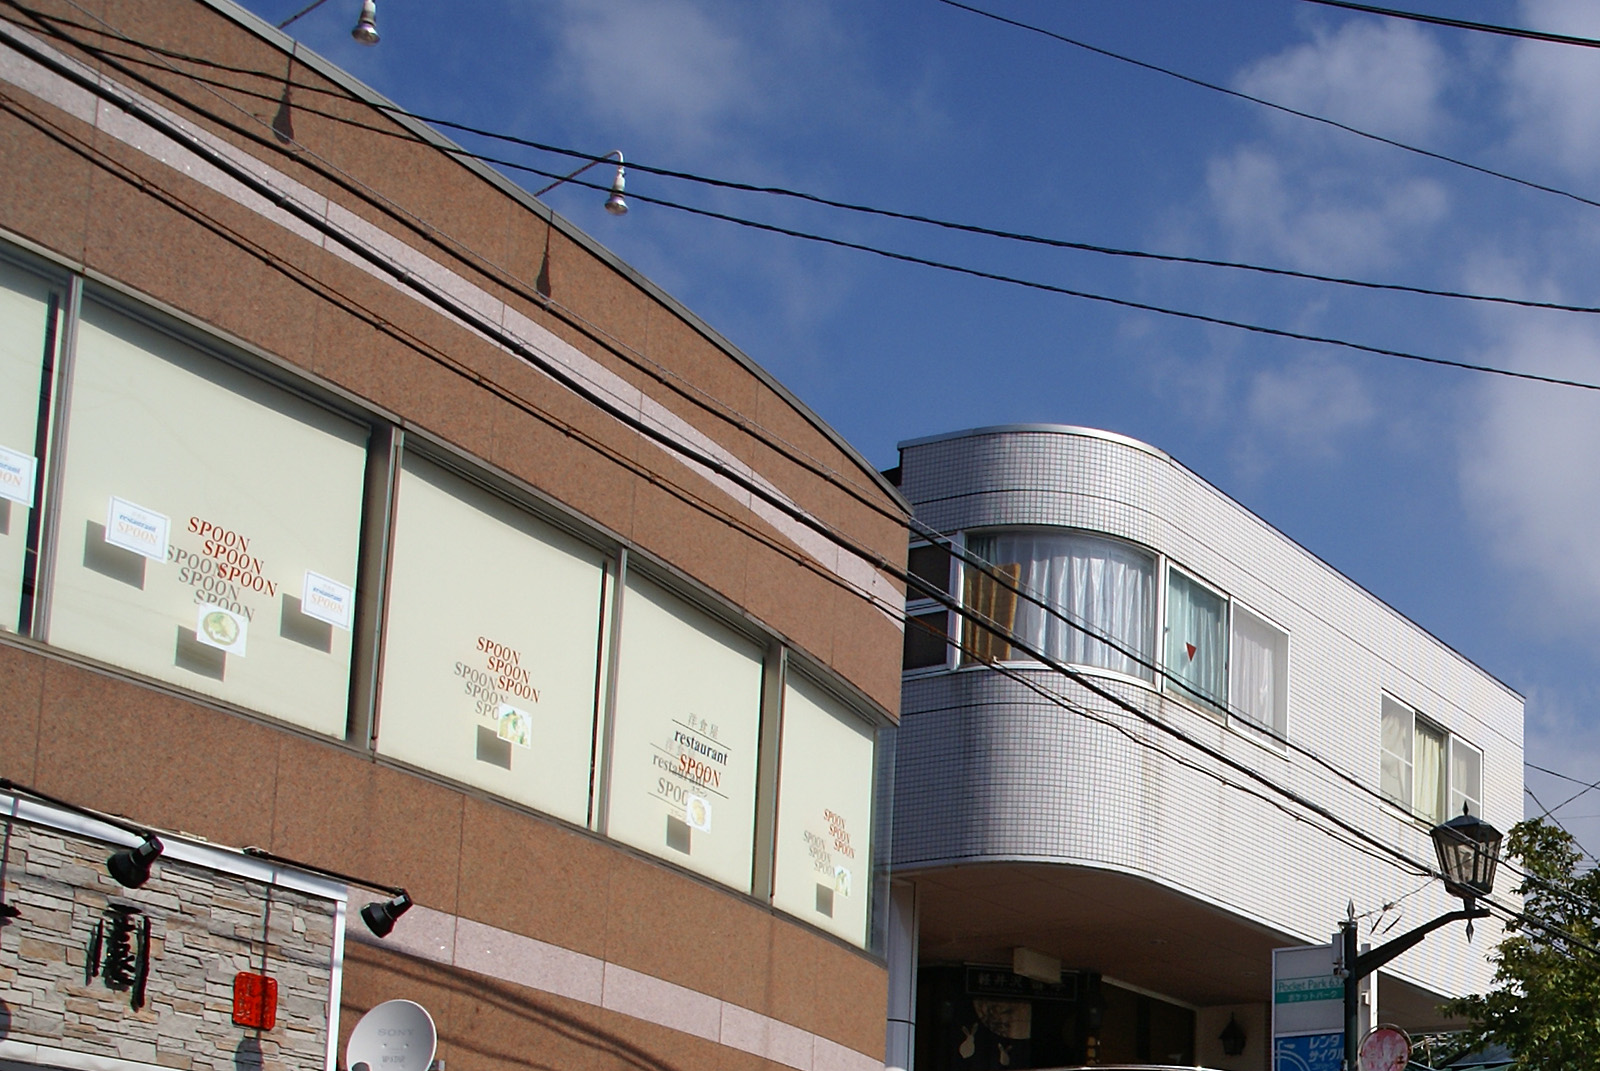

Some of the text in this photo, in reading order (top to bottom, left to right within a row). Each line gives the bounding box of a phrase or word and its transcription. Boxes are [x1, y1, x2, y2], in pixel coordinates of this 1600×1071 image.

[117, 521, 158, 545] SPOON
[188, 516, 250, 553] SPOON
[202, 539, 265, 575] SPOON
[217, 562, 278, 598] SPOON
[476, 636, 521, 666] SPOON
[487, 656, 531, 685] SPOON
[497, 676, 541, 703] SPOON
[674, 729, 728, 766] restaurant
[679, 753, 722, 788] SPOON
[823, 808, 847, 830] SPOON
[829, 824, 851, 844] SPOON
[833, 840, 855, 860] SPOON
[1308, 979, 1326, 989] Park
[377, 1028, 415, 1037] SONY
[1309, 1036, 1340, 1049] レンタ
